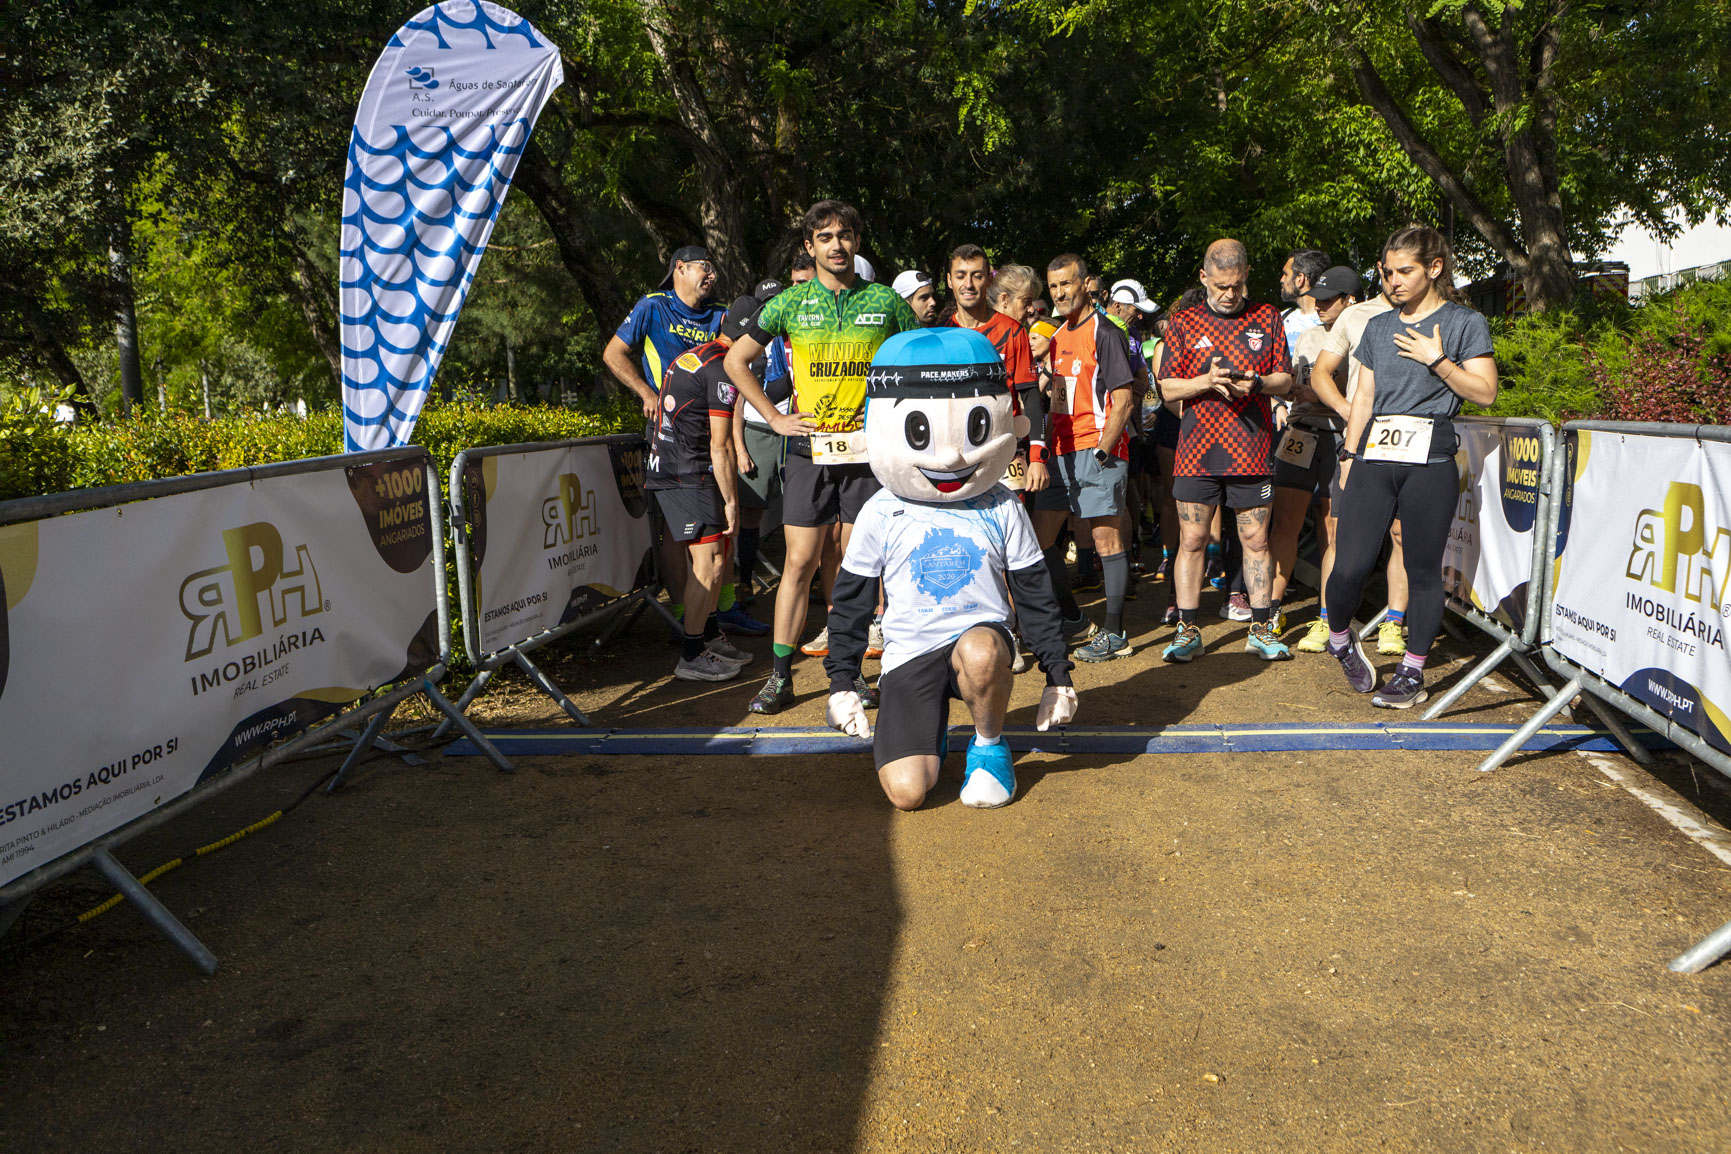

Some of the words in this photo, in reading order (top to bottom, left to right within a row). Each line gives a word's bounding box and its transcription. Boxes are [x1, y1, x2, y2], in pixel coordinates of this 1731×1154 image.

[449, 78, 479, 91] Águas
[482, 79, 493, 90] de
[412, 92, 434, 102] A.S.
[412, 108, 447, 118] Cuidar.
[808, 341, 873, 361] MUNDOS
[809, 361, 871, 378] CRUZADOS
[920, 371, 939, 379] PACE
[940, 370, 969, 378] MAKERS
[824, 440, 847, 453] 18
[1377, 428, 1417, 447] 207
[1004, 462, 1025, 479] 05
[1506, 464, 1537, 488] IMÓVEIS
[375, 467, 422, 499] +1000
[379, 500, 424, 529] IMÓVEIS
[380, 523, 425, 547] ANGARIADOS
[484, 604, 510, 623] ESTAMOS
[510, 599, 527, 613] AQUI
[527, 595, 542, 607] POR
[542, 591, 548, 602] SI
[1577, 615, 1595, 632] AQUI
[1596, 621, 1609, 638] POR
[1609, 629, 1617, 642] SI
[1626, 592, 1724, 650] IMOBILIÁRIA
[1647, 626, 1665, 643] REAL
[1667, 635, 1696, 656] ESTATE
[191, 627, 325, 696] IMOBILIÁRIA
[233, 679, 259, 699] REAL
[262, 662, 290, 687] ESTATE
[234, 711, 297, 747] WWW.RPH.PT
[0, 778, 83, 828] ESTAMOS
[86, 758, 128, 791] AQUI
[131, 748, 163, 771] POR
[166, 737, 179, 753] SI
[16, 829, 40, 849] PINTO
[40, 827, 47, 837] &
[47, 814, 75, 833] HILÁRIO
[79, 796, 112, 818] MEDIAÇÃO
[112, 782, 151, 805] IMOBILIÁRIA,
[1, 853, 15, 866] AMI
